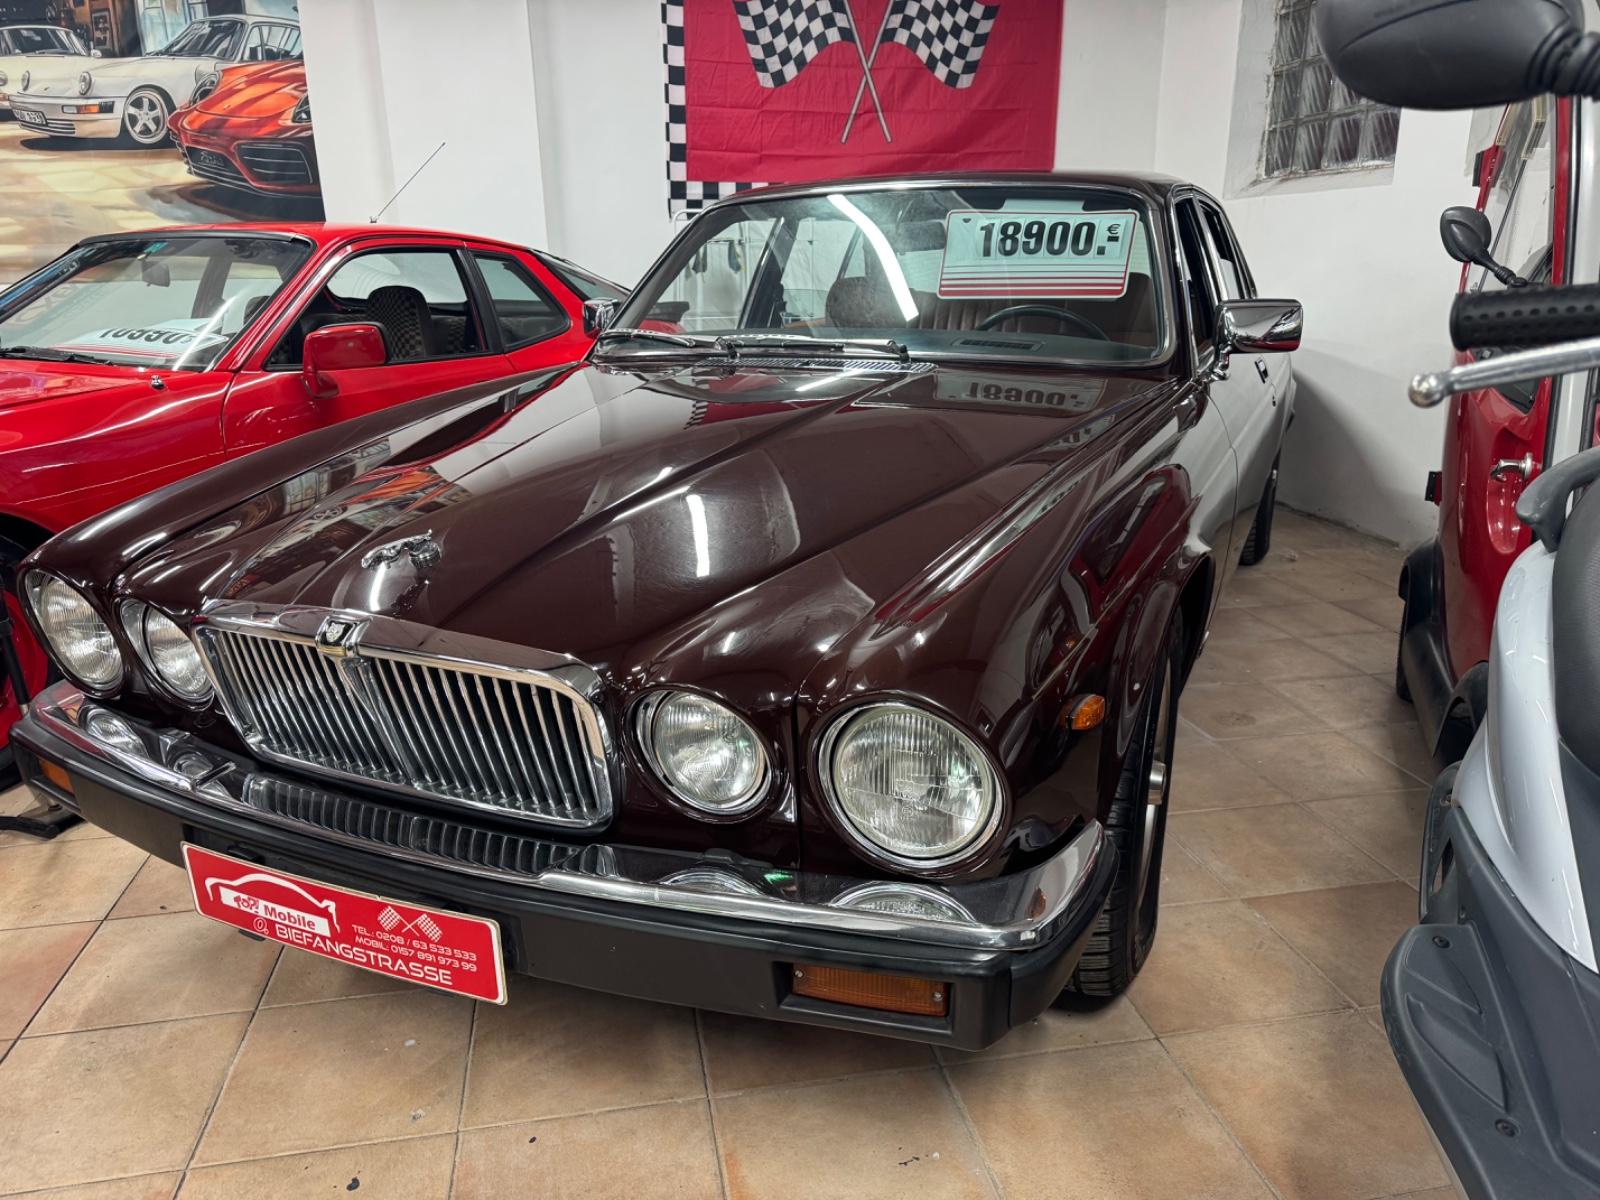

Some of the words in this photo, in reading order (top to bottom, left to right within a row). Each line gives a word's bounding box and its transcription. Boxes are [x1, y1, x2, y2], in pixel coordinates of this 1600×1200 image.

[263, 904, 316, 931] Mobile
[275, 923, 454, 986] BIEFANGSTRASSE
[376, 931, 405, 945] 0208
[412, 940, 428, 950] 63
[429, 943, 453, 956] 533
[453, 949, 477, 961] 533
[390, 945, 415, 957] 0157
[417, 951, 437, 963] 891
[437, 956, 460, 968] 973
[461, 962, 478, 973] 99
